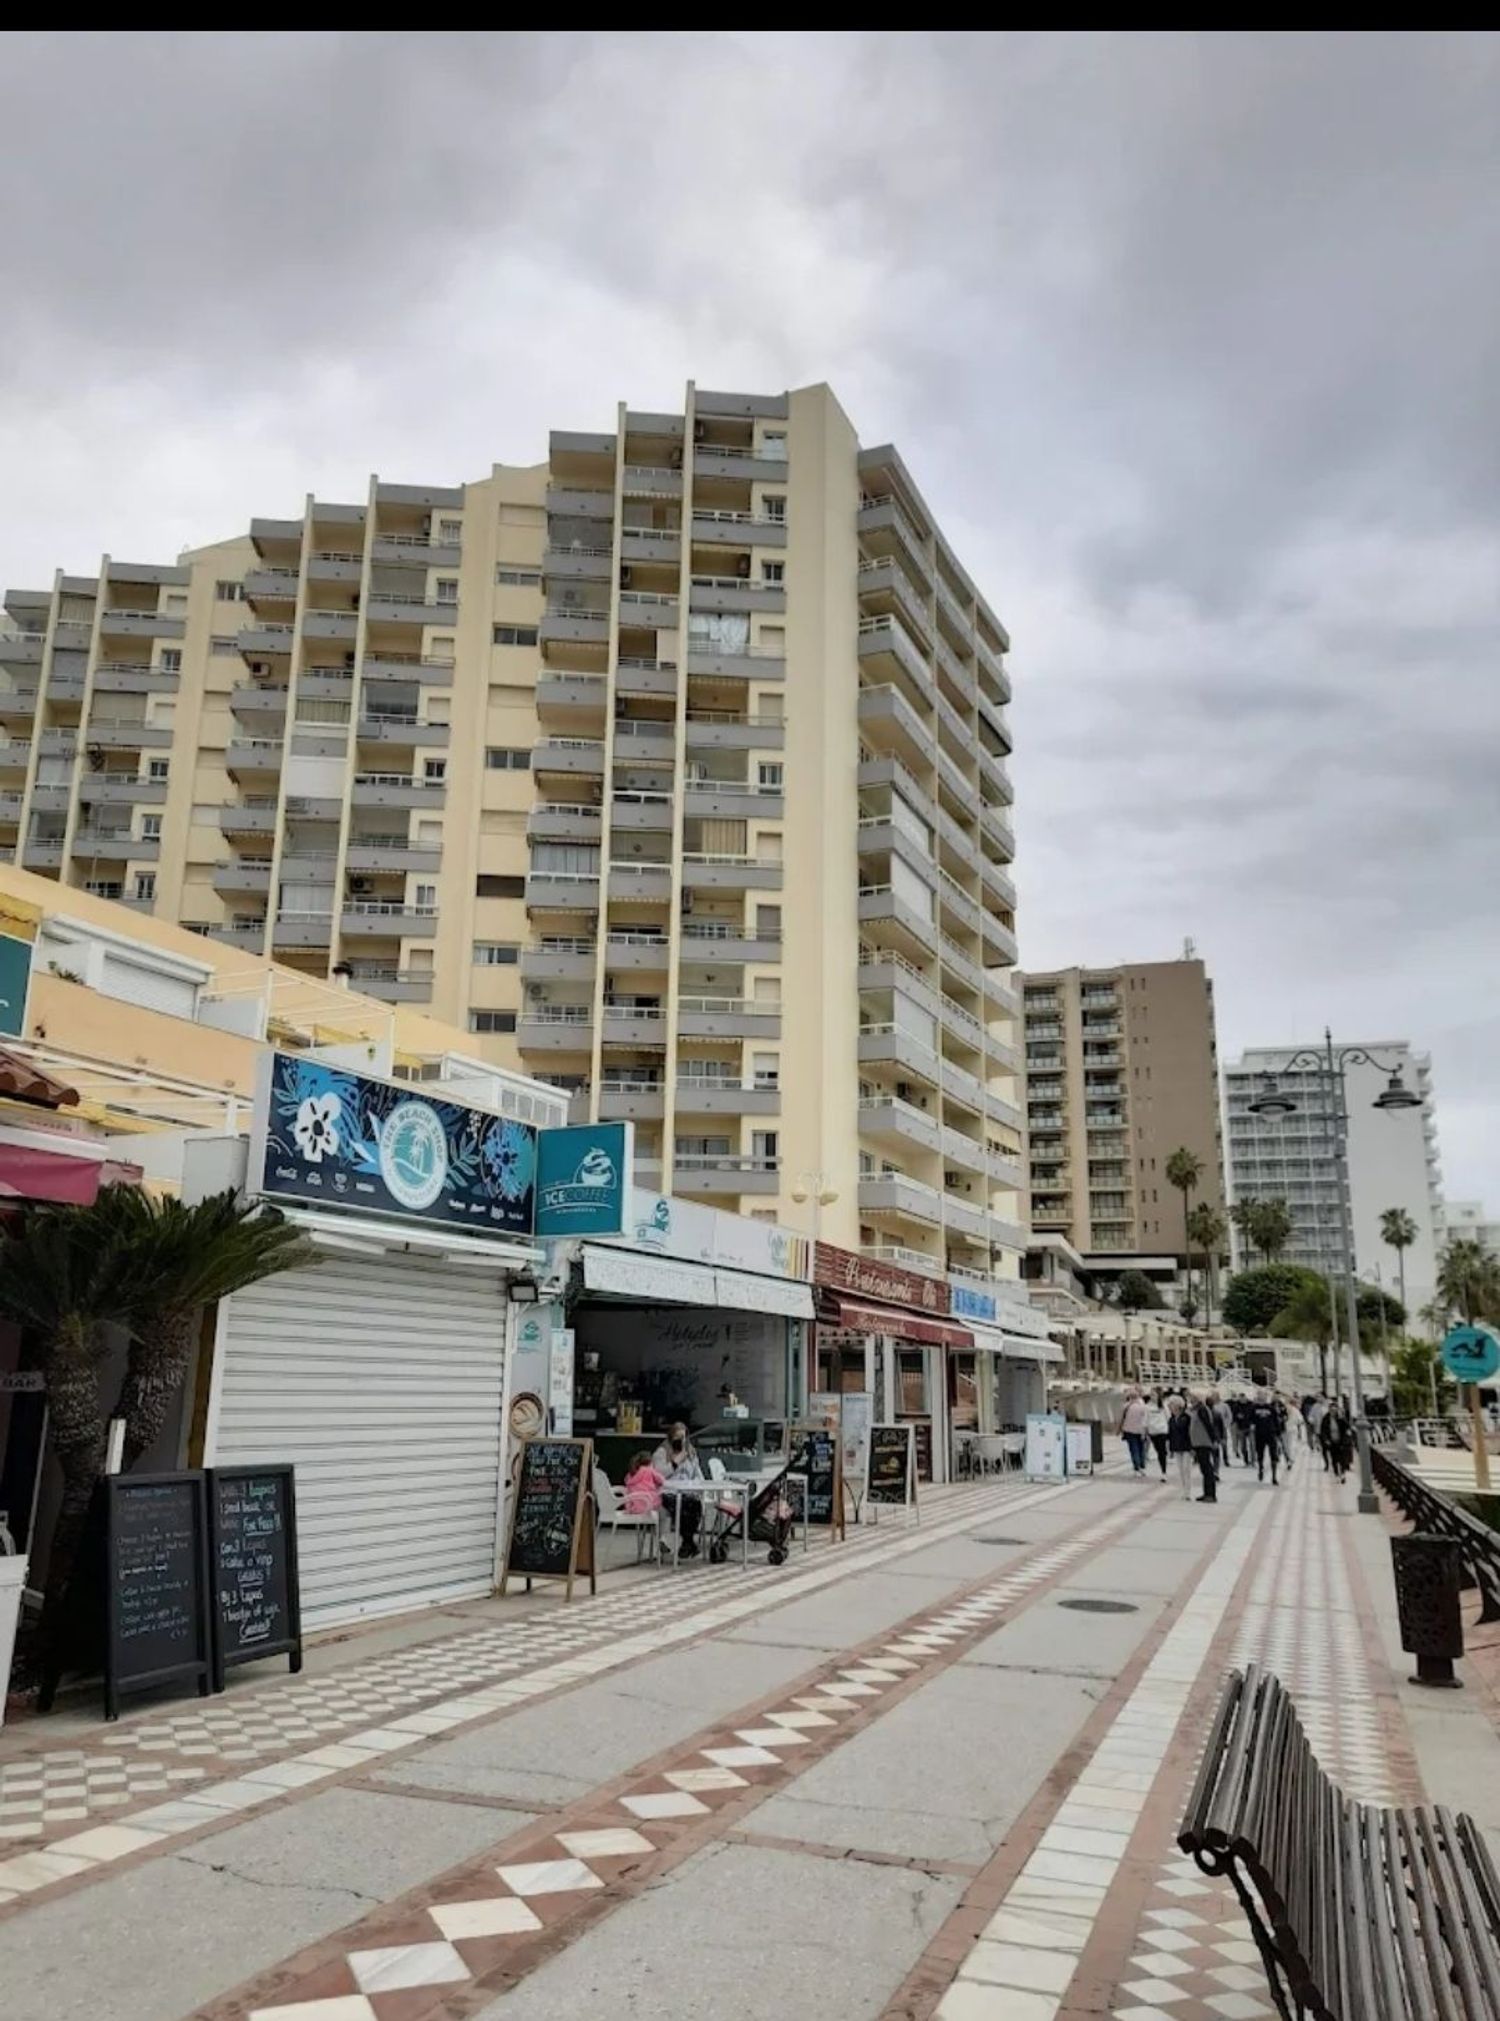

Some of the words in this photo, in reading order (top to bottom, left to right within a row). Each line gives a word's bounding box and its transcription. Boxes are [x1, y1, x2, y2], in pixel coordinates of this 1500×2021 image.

[384, 1122, 398, 1148] THE
[400, 1106, 433, 1126] BEACH
[431, 1126, 445, 1164] SHOP
[545, 1190, 565, 1206] ICE
